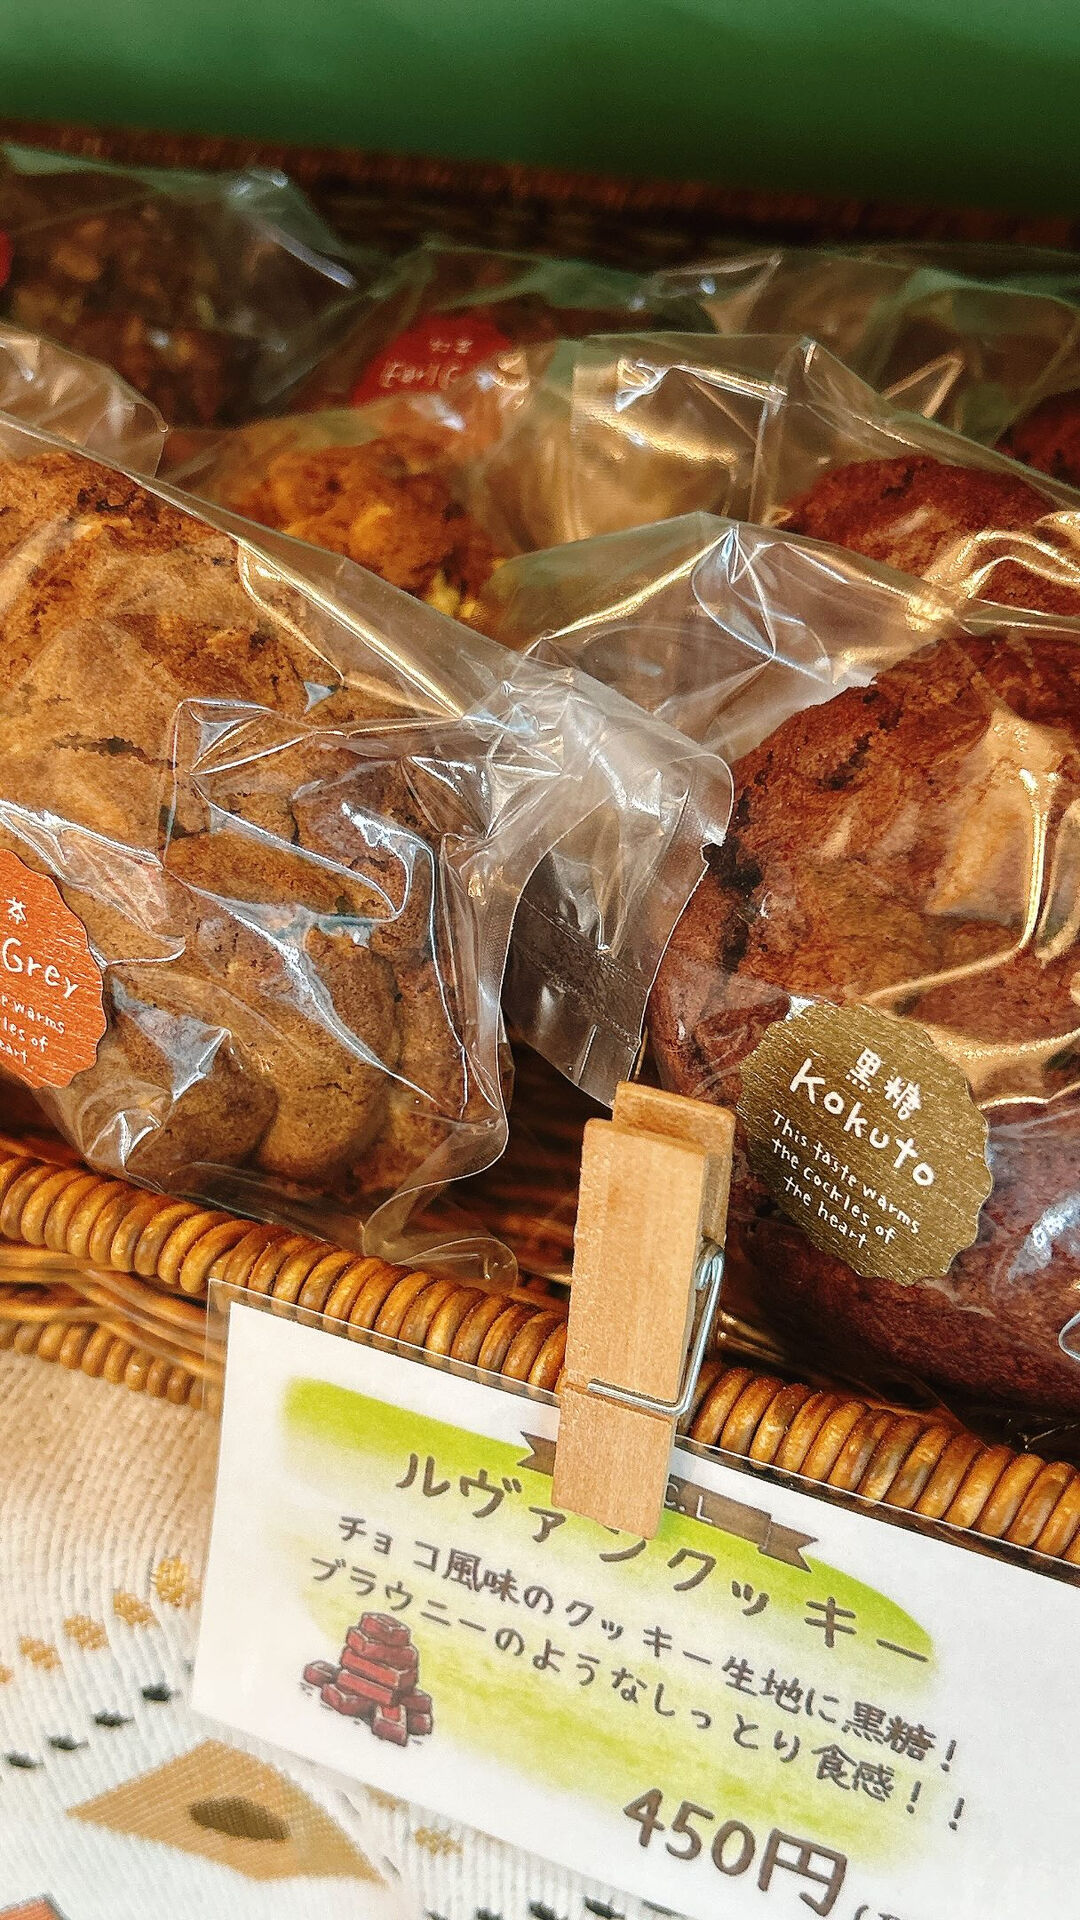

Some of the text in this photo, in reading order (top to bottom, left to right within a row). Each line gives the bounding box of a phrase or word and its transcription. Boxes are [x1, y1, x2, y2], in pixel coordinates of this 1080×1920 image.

[2, 937, 79, 999] Grey
[13, 1000, 65, 1034] warms
[31, 1035, 48, 1053] of
[845, 1047, 922, 1120] 黒糖
[789, 1057, 936, 1187] Kokuto
[772, 1109, 920, 1234] This taste warms
[772, 1137, 898, 1245] the cockles of
[783, 1176, 812, 1207] the
[622, 1787, 848, 1917] 450円
